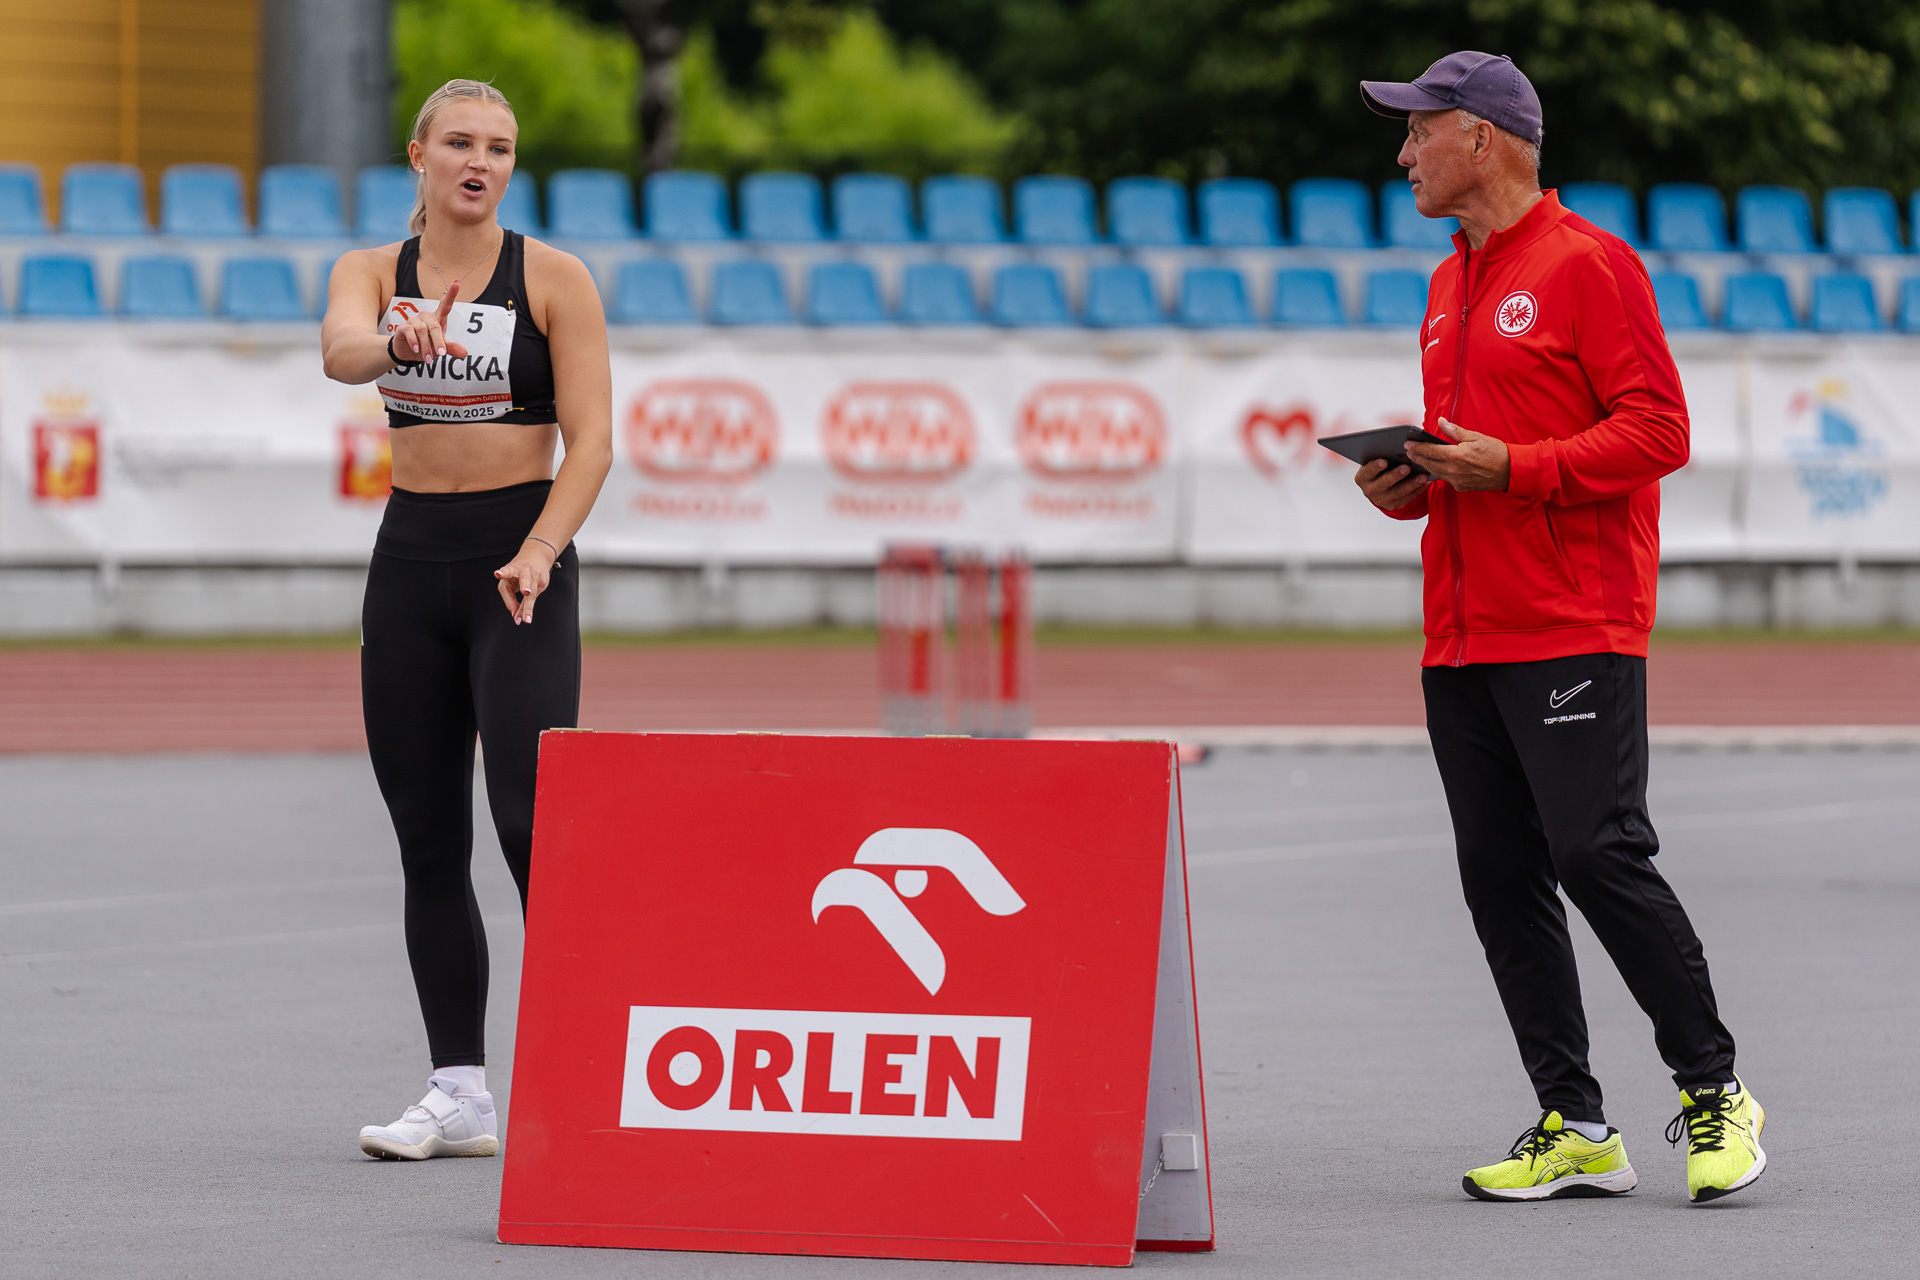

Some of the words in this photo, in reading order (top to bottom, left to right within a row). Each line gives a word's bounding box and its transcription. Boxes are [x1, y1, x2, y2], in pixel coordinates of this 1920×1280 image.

[467, 312, 484, 334] 5
[388, 355, 504, 382] WICKA
[394, 401, 461, 418] WARSZAWA
[463, 406, 494, 418] 2025
[646, 1025, 1001, 1119] ORLEN
